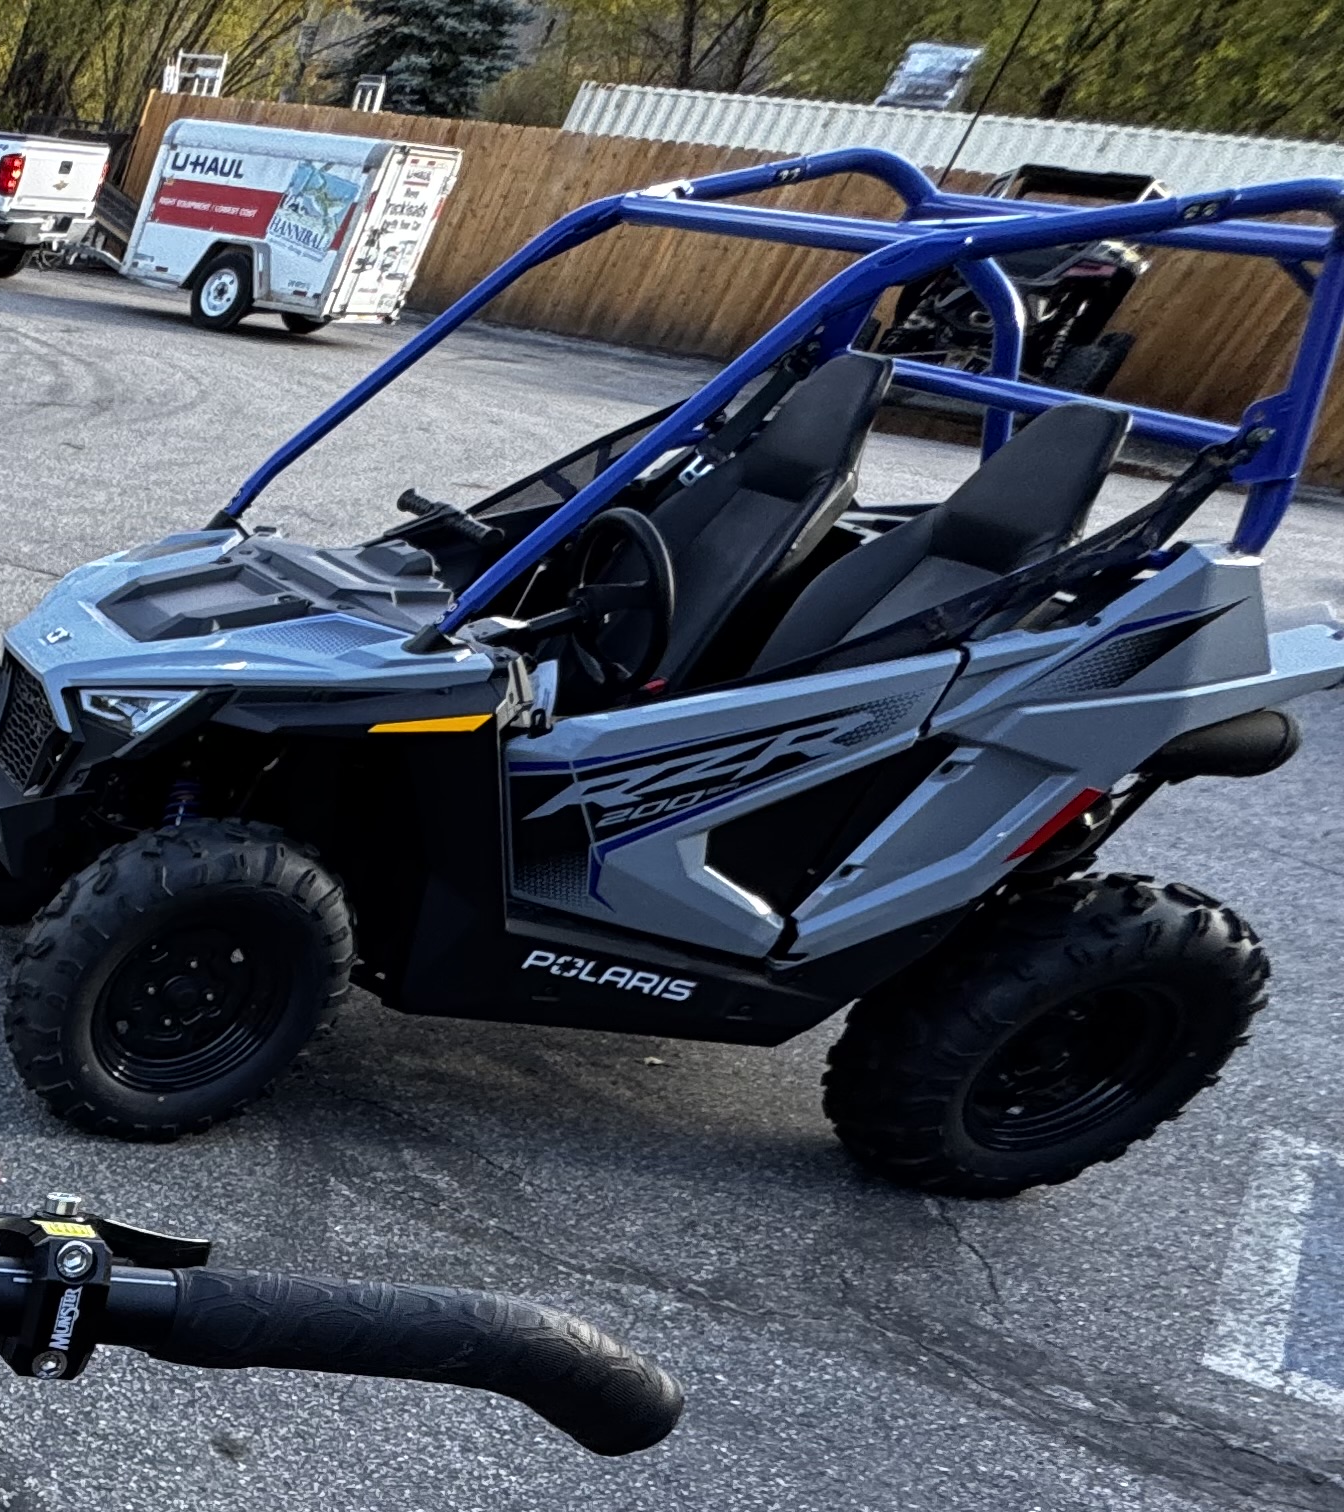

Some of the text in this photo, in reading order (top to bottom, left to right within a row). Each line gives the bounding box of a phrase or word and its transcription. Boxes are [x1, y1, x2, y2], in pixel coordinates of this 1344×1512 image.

[171, 152, 245, 179] U-HAUL
[521, 712, 874, 820] RZR
[596, 789, 705, 828] 200
[521, 949, 698, 1002] POLARIS
